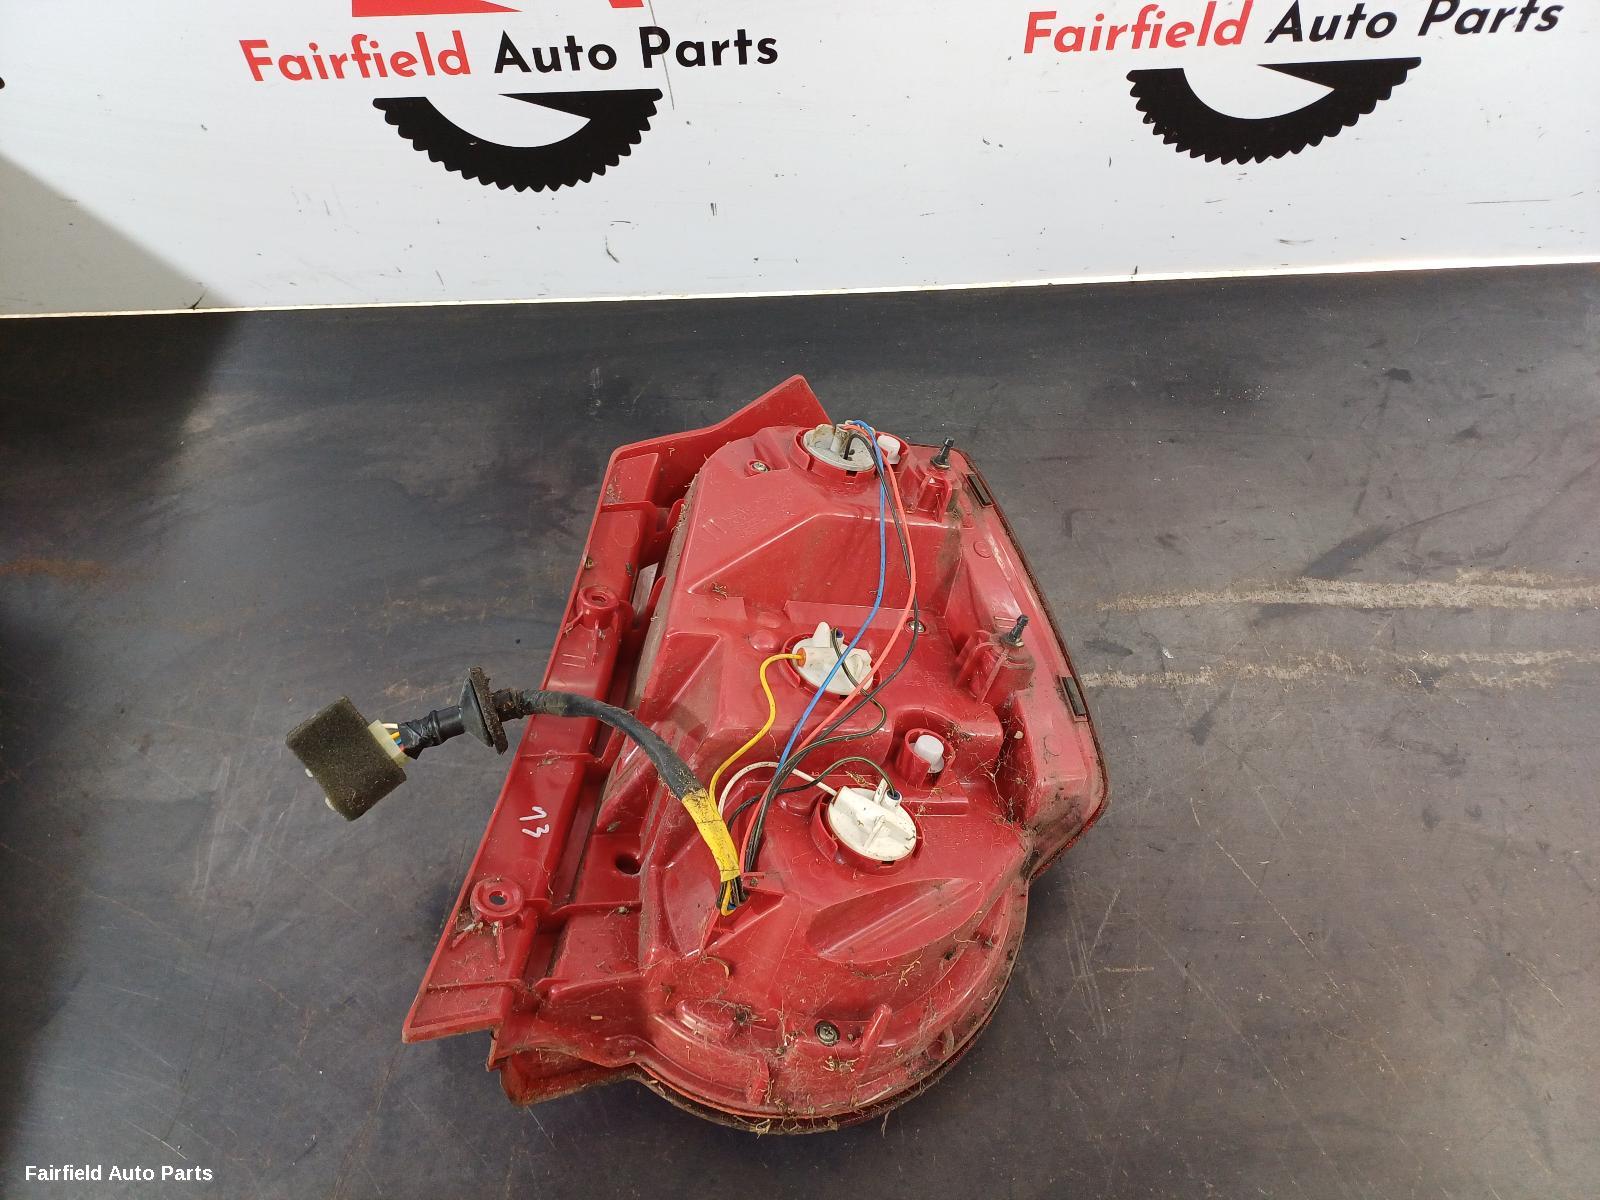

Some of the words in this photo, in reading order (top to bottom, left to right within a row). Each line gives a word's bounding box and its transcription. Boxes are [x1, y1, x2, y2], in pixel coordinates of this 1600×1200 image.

[239, 29, 471, 82] Fairfield
[494, 30, 617, 74] Auto
[638, 25, 778, 69] Parts
[1023, 0, 1254, 54] Fairfield
[1264, 0, 1398, 44] Auto
[1417, 0, 1564, 37] Parts
